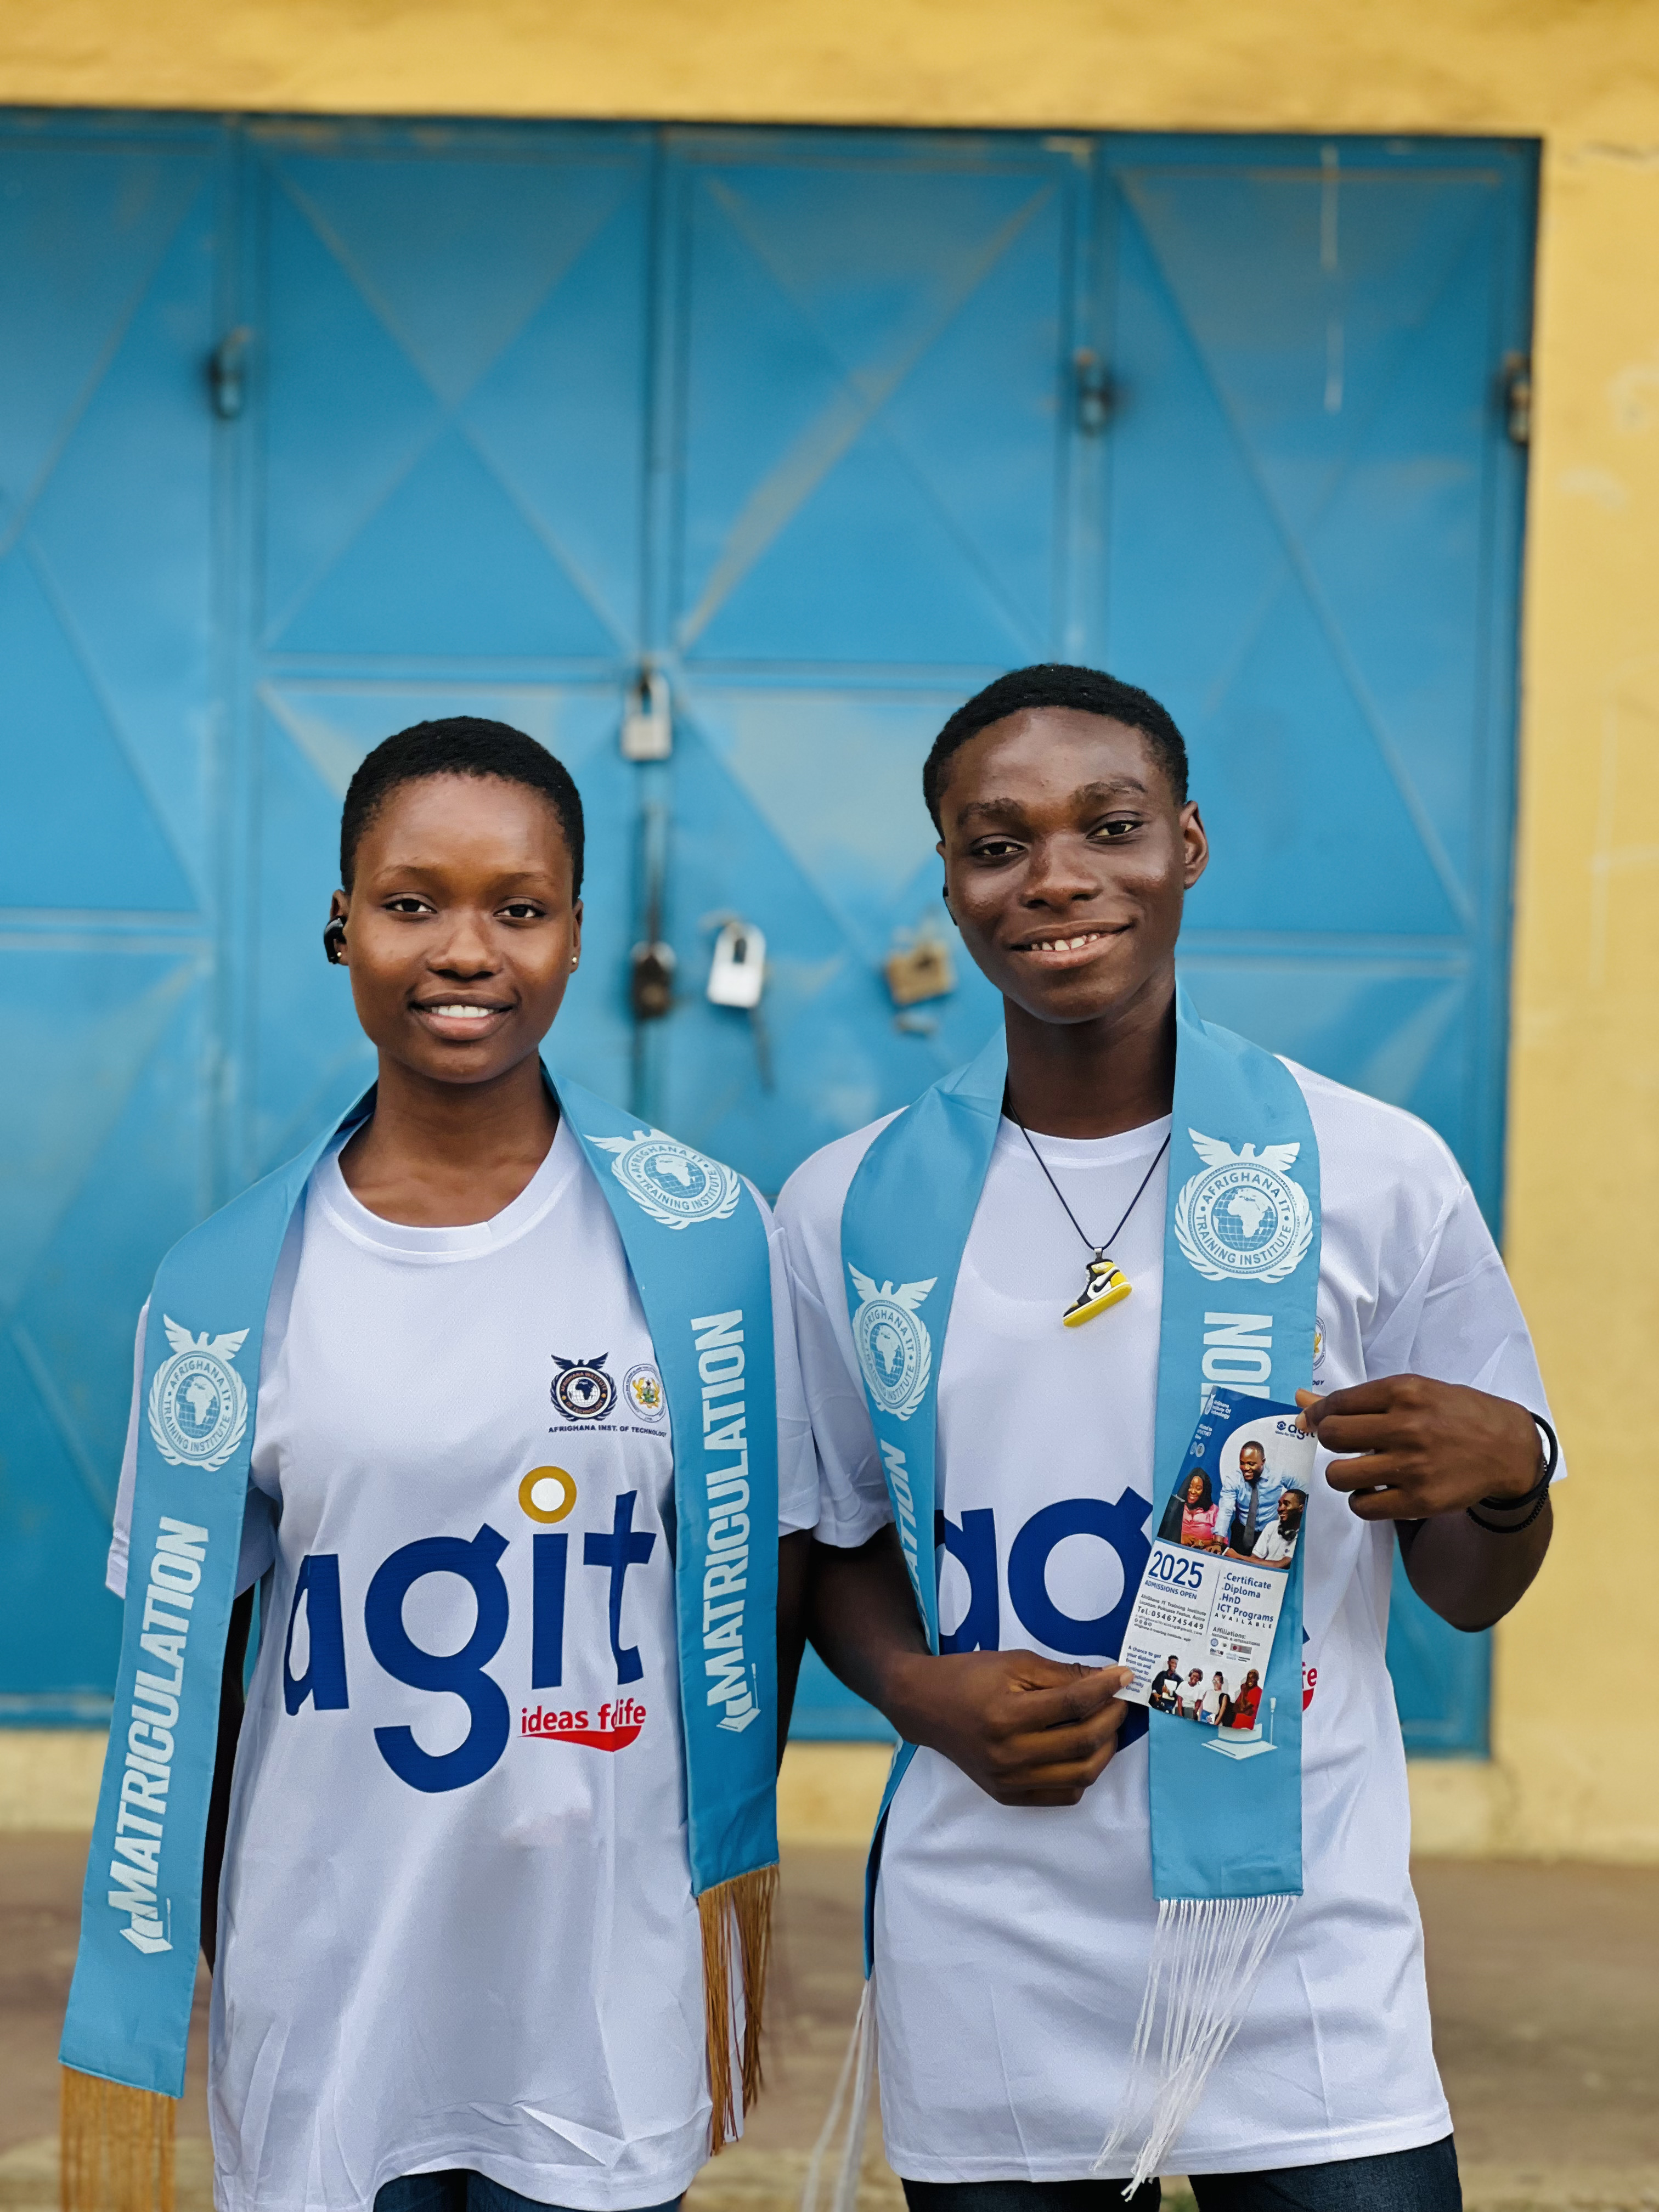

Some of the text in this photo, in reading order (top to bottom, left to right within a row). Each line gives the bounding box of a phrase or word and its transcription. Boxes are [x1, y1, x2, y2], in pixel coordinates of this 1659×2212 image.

[630, 1145, 687, 1173] AFRIGHANA
[640, 1169, 720, 1210] TRAINING INSTITUTE
[1203, 1172, 1290, 1214] AFRIGHANA IT
[1196, 1214, 1292, 1265] TRAINING INSTITUTE
[863, 1308, 915, 1352] AFRIGHANA IT
[170, 1359, 232, 1403] AFRIGHANA IT
[887, 1364, 915, 1401] INSTITUTE
[162, 1400, 230, 1452] TRAINING INSTITUTE
[631, 1426, 667, 1437] TECHNOLOGY
[691, 1310, 750, 1706] MATRICULATION
[1148, 1550, 1204, 1588] 2025
[1226, 1572, 1272, 1590] Certificate
[1144, 1579, 1198, 1600] ADMISSIONS OPEN
[1222, 1593, 1240, 1604] HnD
[1224, 1583, 1261, 1599] Diploma
[284, 1465, 657, 1793] agit
[1214, 1612, 1272, 1629] AVAILABLE
[1217, 1602, 1273, 1622] ICT Programs
[1212, 1627, 1246, 1639] Affiliations:
[108, 1516, 208, 1918] MATRICULATION
[522, 1705, 589, 1734] ideas
